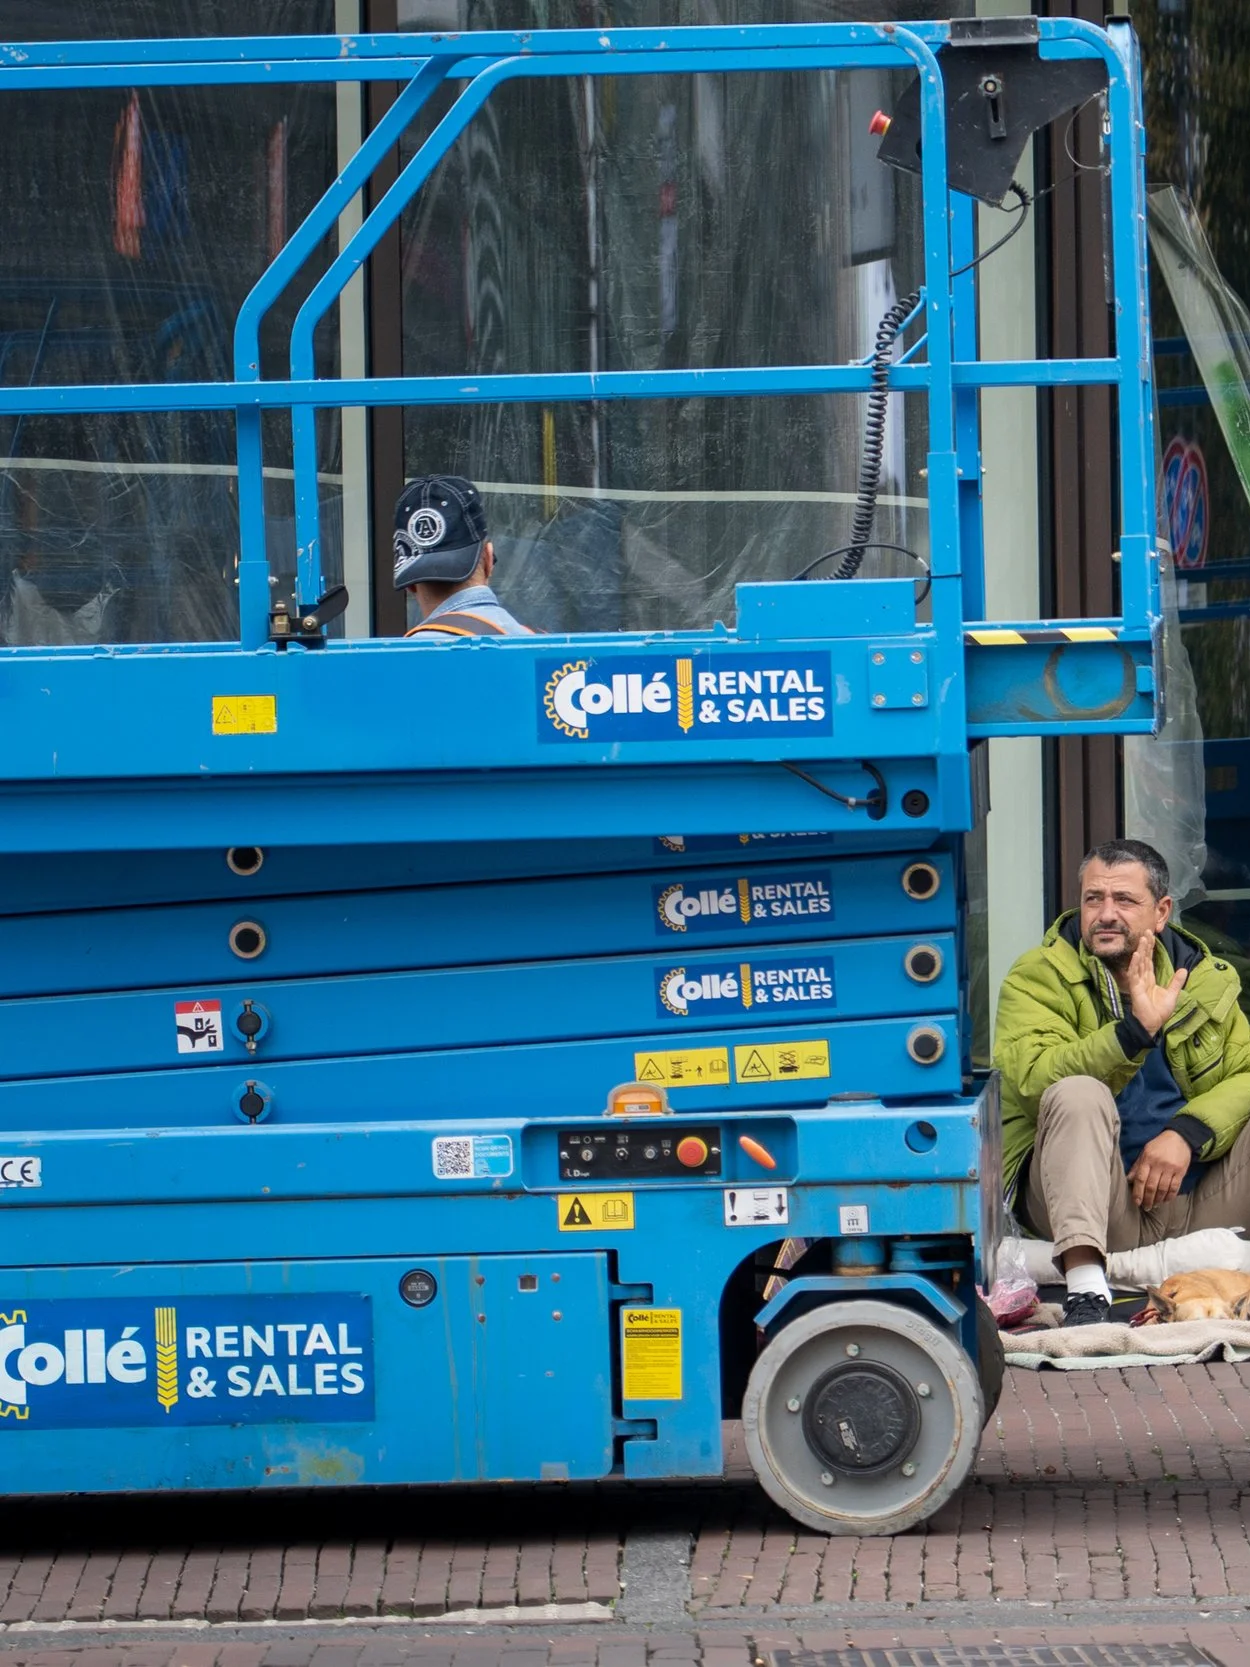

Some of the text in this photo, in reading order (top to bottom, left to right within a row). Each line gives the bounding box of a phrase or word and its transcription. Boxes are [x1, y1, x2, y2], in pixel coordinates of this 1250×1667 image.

[698, 669, 824, 696] RENTAL
[553, 671, 672, 729] Collé
[699, 697, 826, 724] & SALES
[752, 881, 830, 901] RENTAL
[664, 888, 737, 926] Collé
[753, 898, 831, 918] & SALES
[754, 967, 832, 986] RENTAL
[665, 972, 739, 1009] Collé
[755, 984, 833, 1003] & SALES
[1, 1160, 34, 1183] CE
[185, 1323, 363, 1359] RENTAL
[0, 1324, 147, 1405] Collé
[186, 1362, 365, 1398] & SALES
